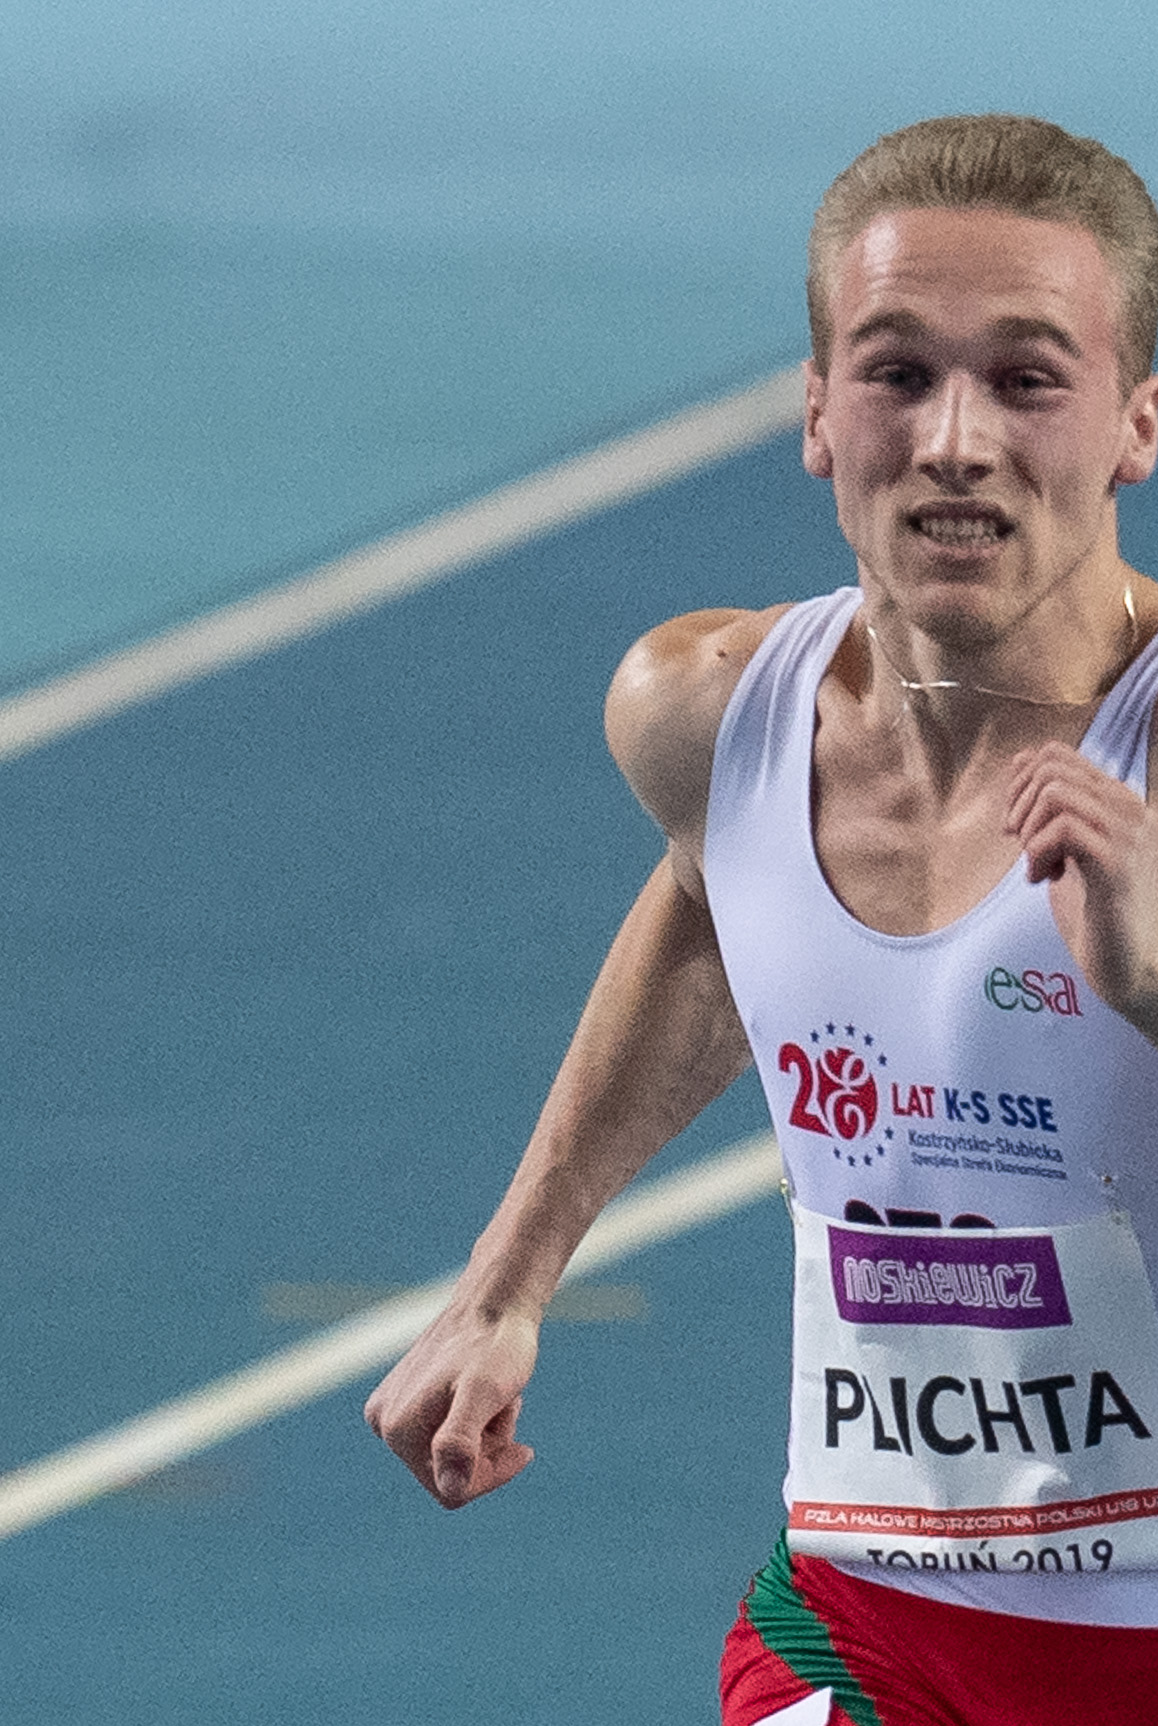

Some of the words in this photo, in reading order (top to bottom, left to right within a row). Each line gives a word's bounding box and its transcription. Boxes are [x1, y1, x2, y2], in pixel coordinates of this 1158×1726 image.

[891, 1082, 935, 1118] LAT
[945, 1086, 990, 1125] K-S
[998, 1092, 1058, 1132] SSE
[824, 1367, 1152, 1456] PLICHTA
[850, 1512, 918, 1528] HALOWE
[1036, 1506, 1103, 1525] POLSKI
